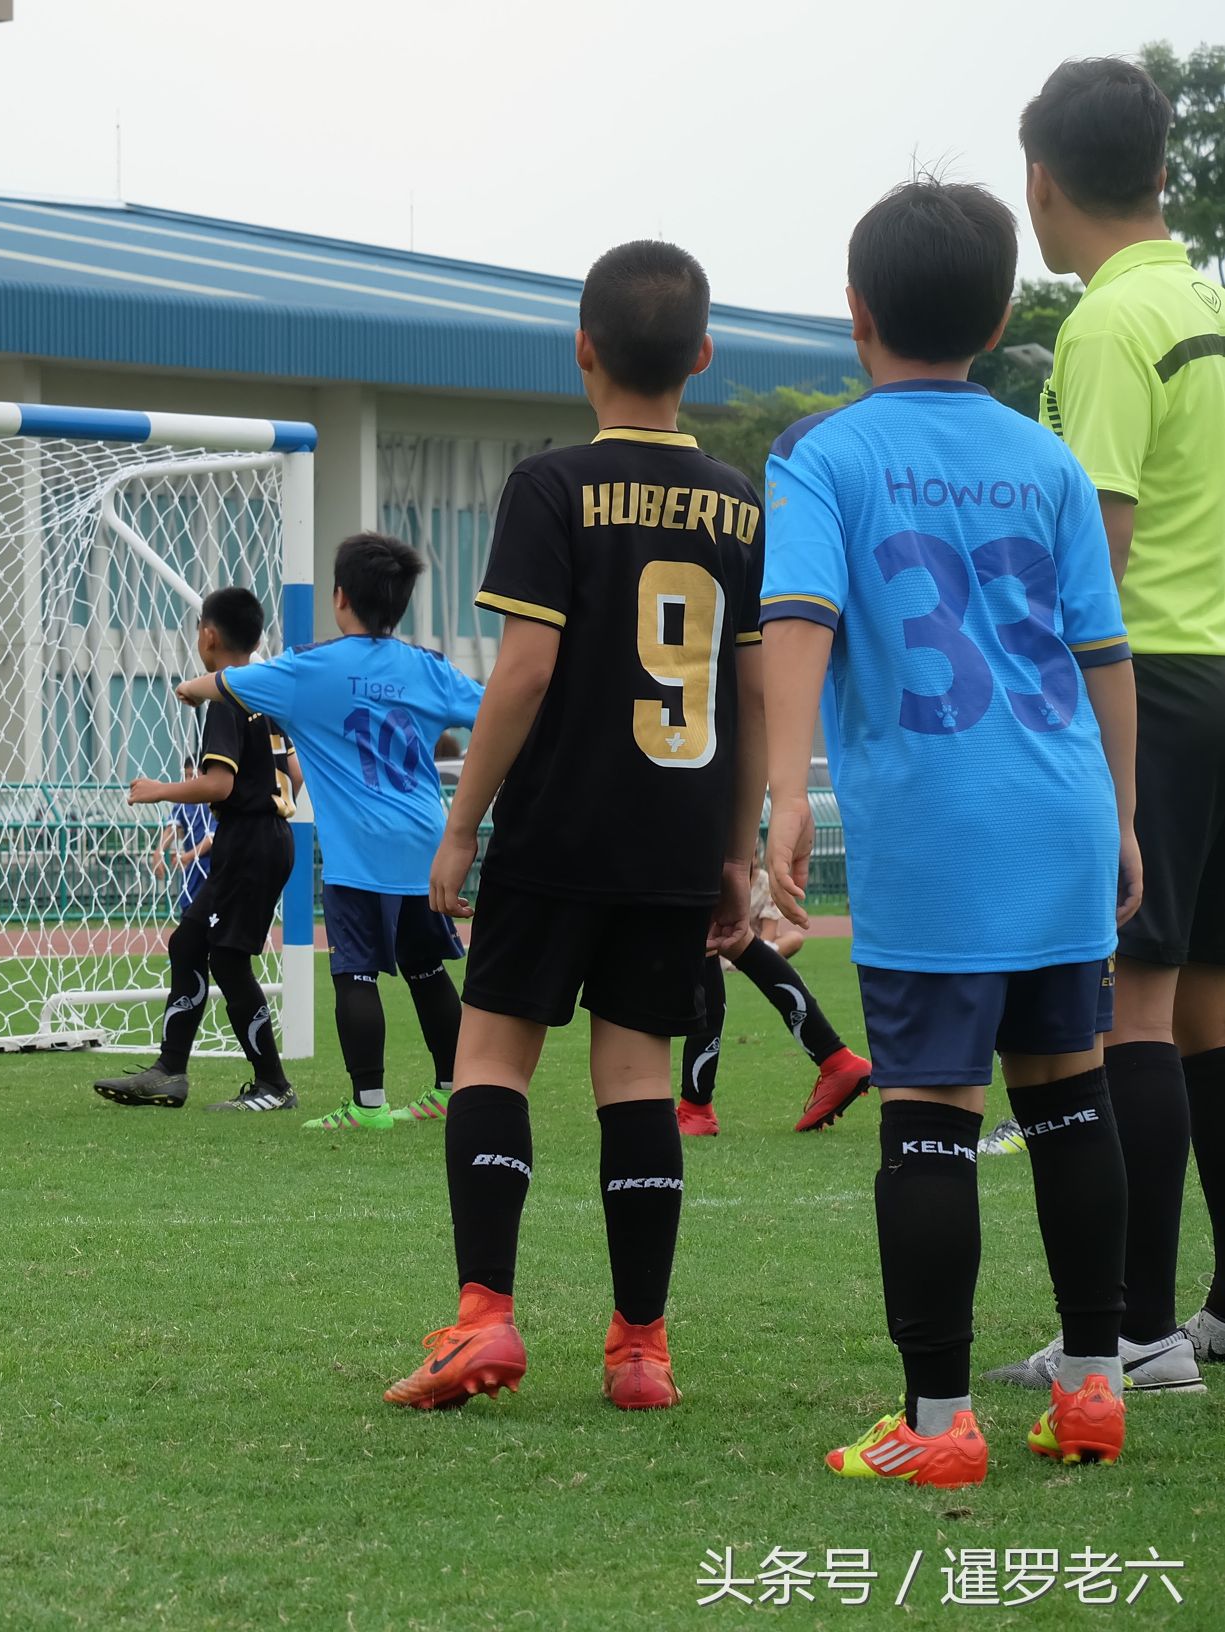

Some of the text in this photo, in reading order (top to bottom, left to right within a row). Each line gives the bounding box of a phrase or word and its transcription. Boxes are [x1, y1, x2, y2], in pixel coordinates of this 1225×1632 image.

[885, 466, 1042, 512] Howon
[582, 481, 760, 545] HUBERTO
[873, 530, 1079, 735] 33
[632, 560, 725, 769] 9
[347, 676, 406, 701] Tiger
[343, 707, 419, 794] 10
[354, 974, 376, 983] KEL
[1022, 1109, 1099, 1138] KELME
[902, 1140, 976, 1163] KELME
